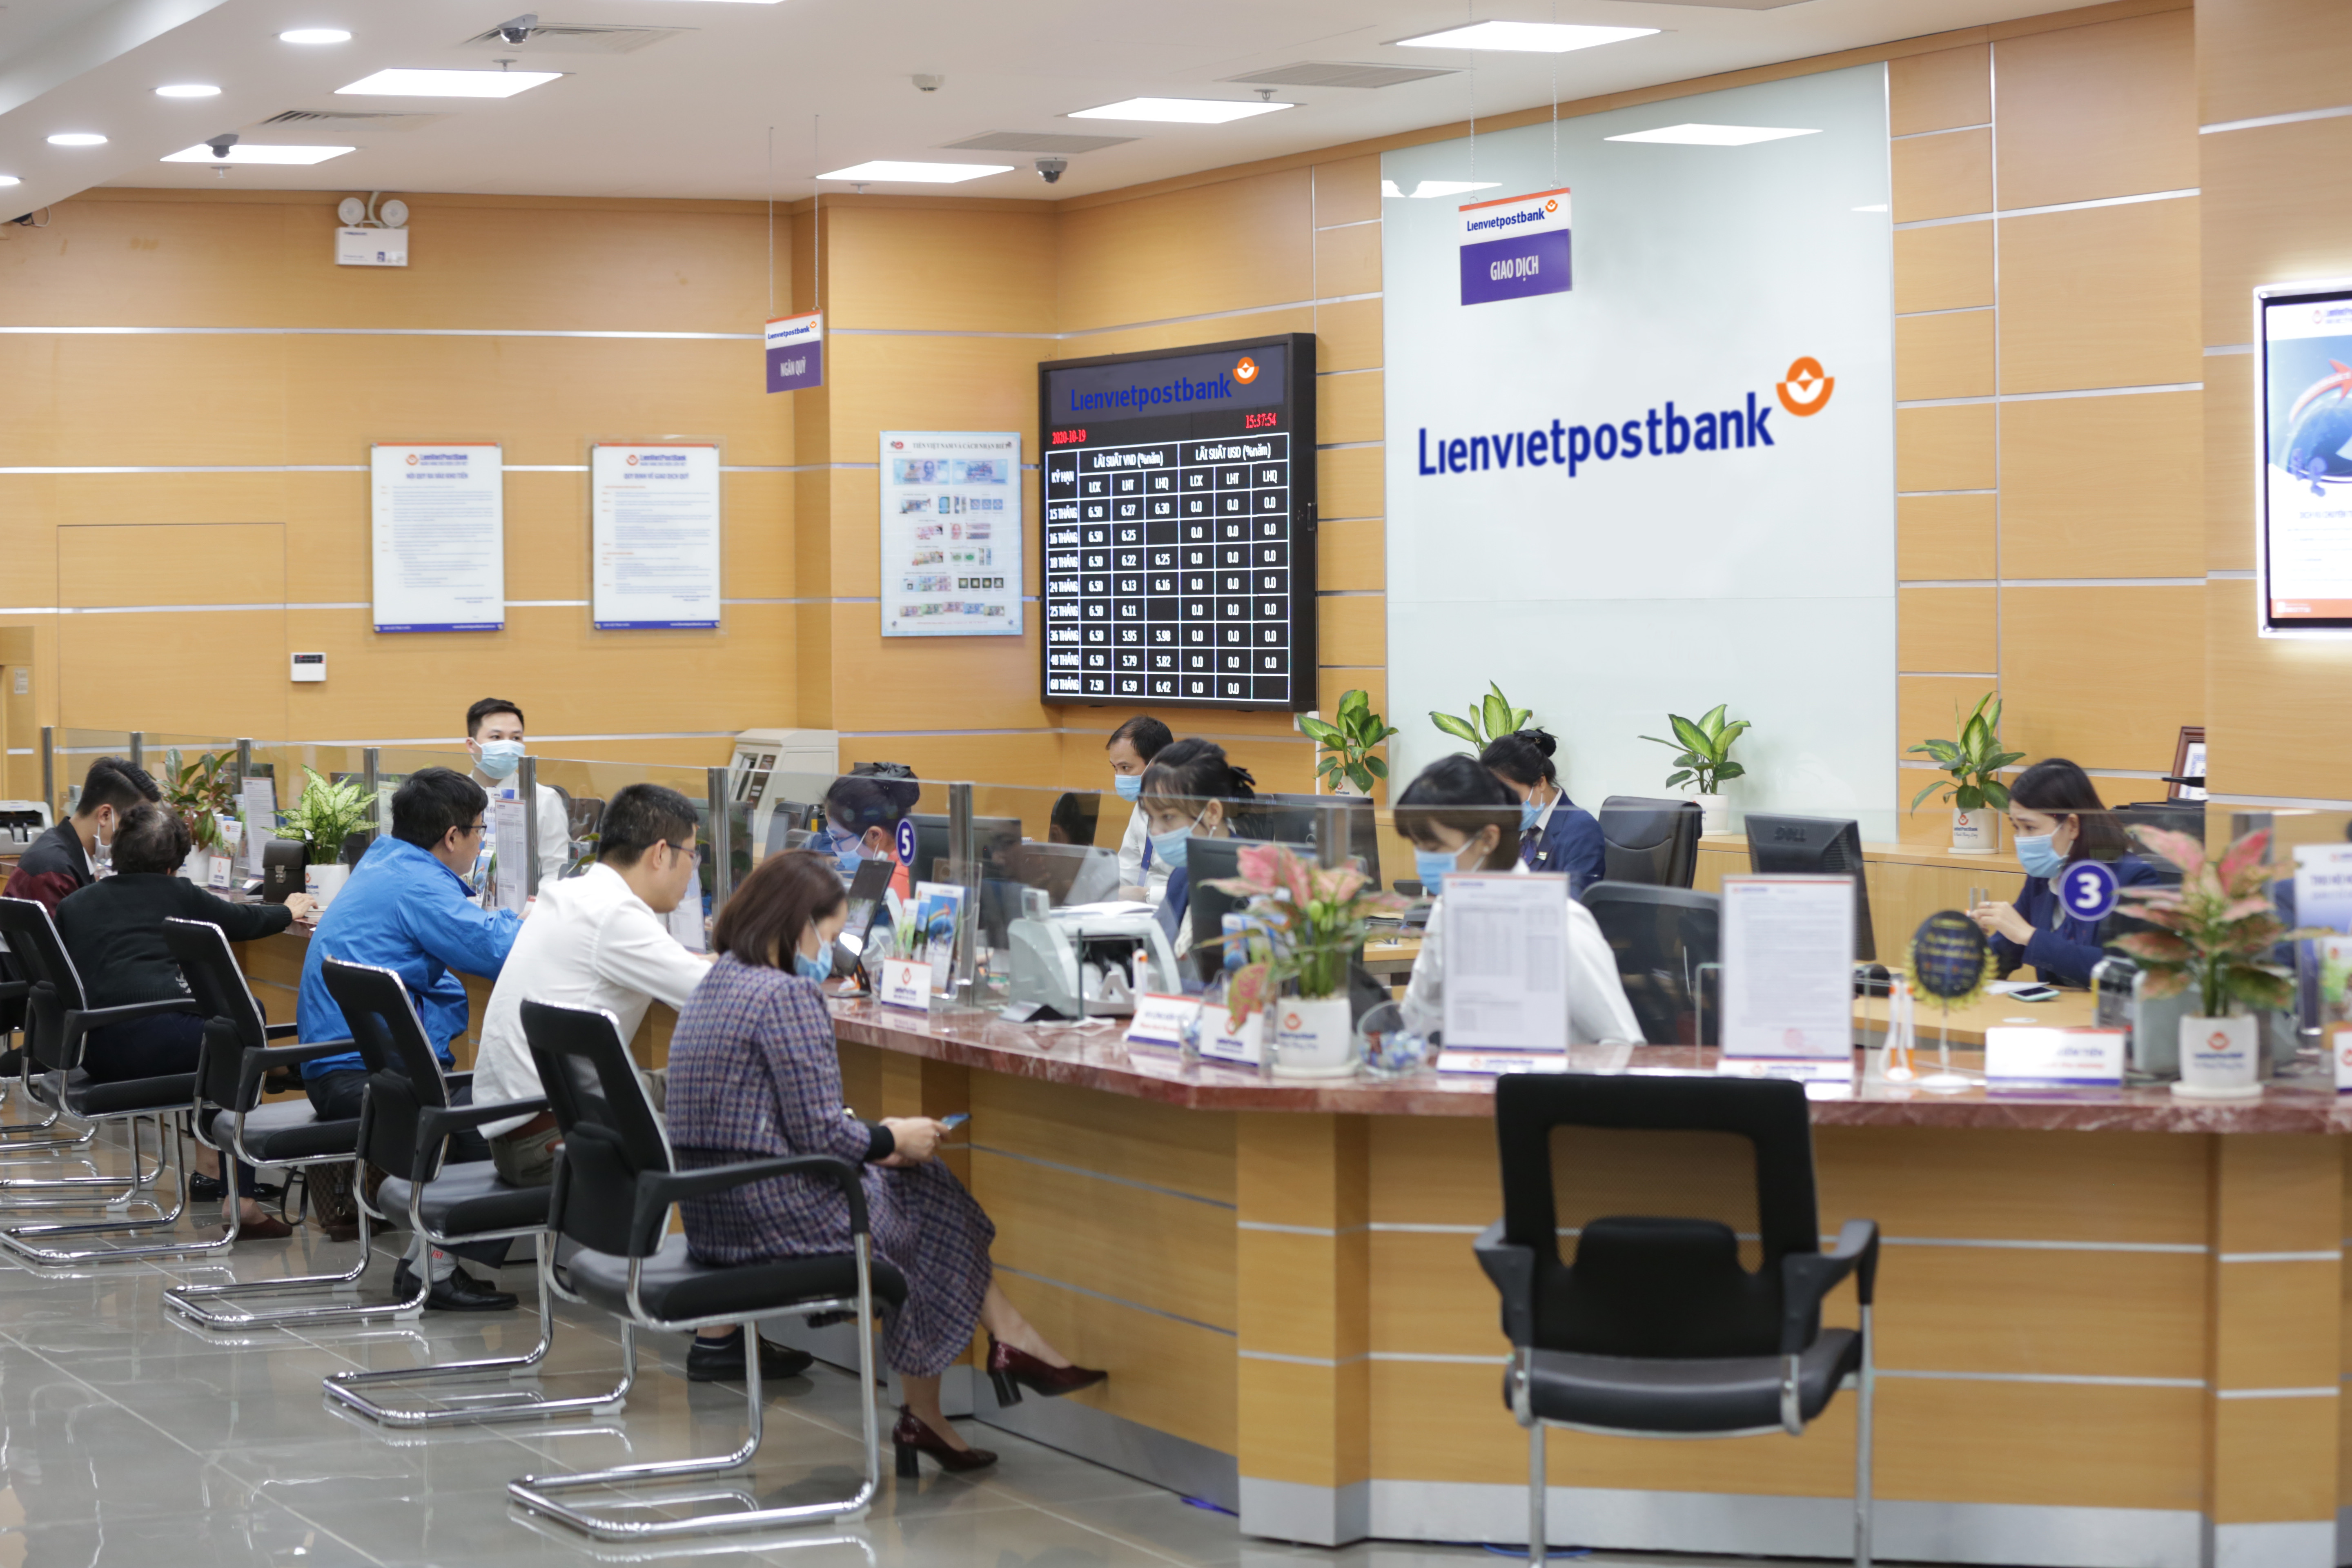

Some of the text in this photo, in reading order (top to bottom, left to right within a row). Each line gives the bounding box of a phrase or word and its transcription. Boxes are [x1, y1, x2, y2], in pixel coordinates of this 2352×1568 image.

[1467, 207, 1545, 232] Lienvietpostbank
[1490, 255, 1539, 282] GIAO DỊCH
[1071, 373, 1232, 411] Lienvietpostbank
[1245, 412, 1277, 428] 15:37:54
[1052, 429, 1087, 444] 2020-10-19
[1419, 392, 1775, 478] Lienvietpostbank
[1123, 454, 1136, 466] VND
[1227, 447, 1241, 459] USD
[1089, 470, 1277, 492] LCK LHT LHQ LCK LHT LHQ
[1049, 497, 1276, 520] 15 THÁNG 6.50 6.27 6.30 0.0 0.0 0.0
[1049, 523, 1276, 544] 16 THÁNG 6.50 6.25 0.0 0.0 0.0
[1049, 550, 1276, 568] 18 THÁNG 6.50 6.22 6.25 0.0 0.0 0.0
[1049, 577, 1276, 593] 24 THÁNG 6.50 6.13 6.16 0.0 0.0 0.0
[1049, 603, 1276, 617] 25 THÁNG 6.50 6.11 0.0 0.0 0.0
[1050, 627, 1276, 642] 36 THÁNG 6.50 5.95 5.98 0.0 0.0 0.0
[1050, 652, 1277, 668] 48 THÁNG 6.50 5.79 5.82 0.0 0.0 0.0
[1050, 676, 1239, 695] 60 THÁNG 7.50 6.39 6.42 0.0 0.0
[901, 828, 911, 857] 5
[2075, 873, 2103, 909] 3
